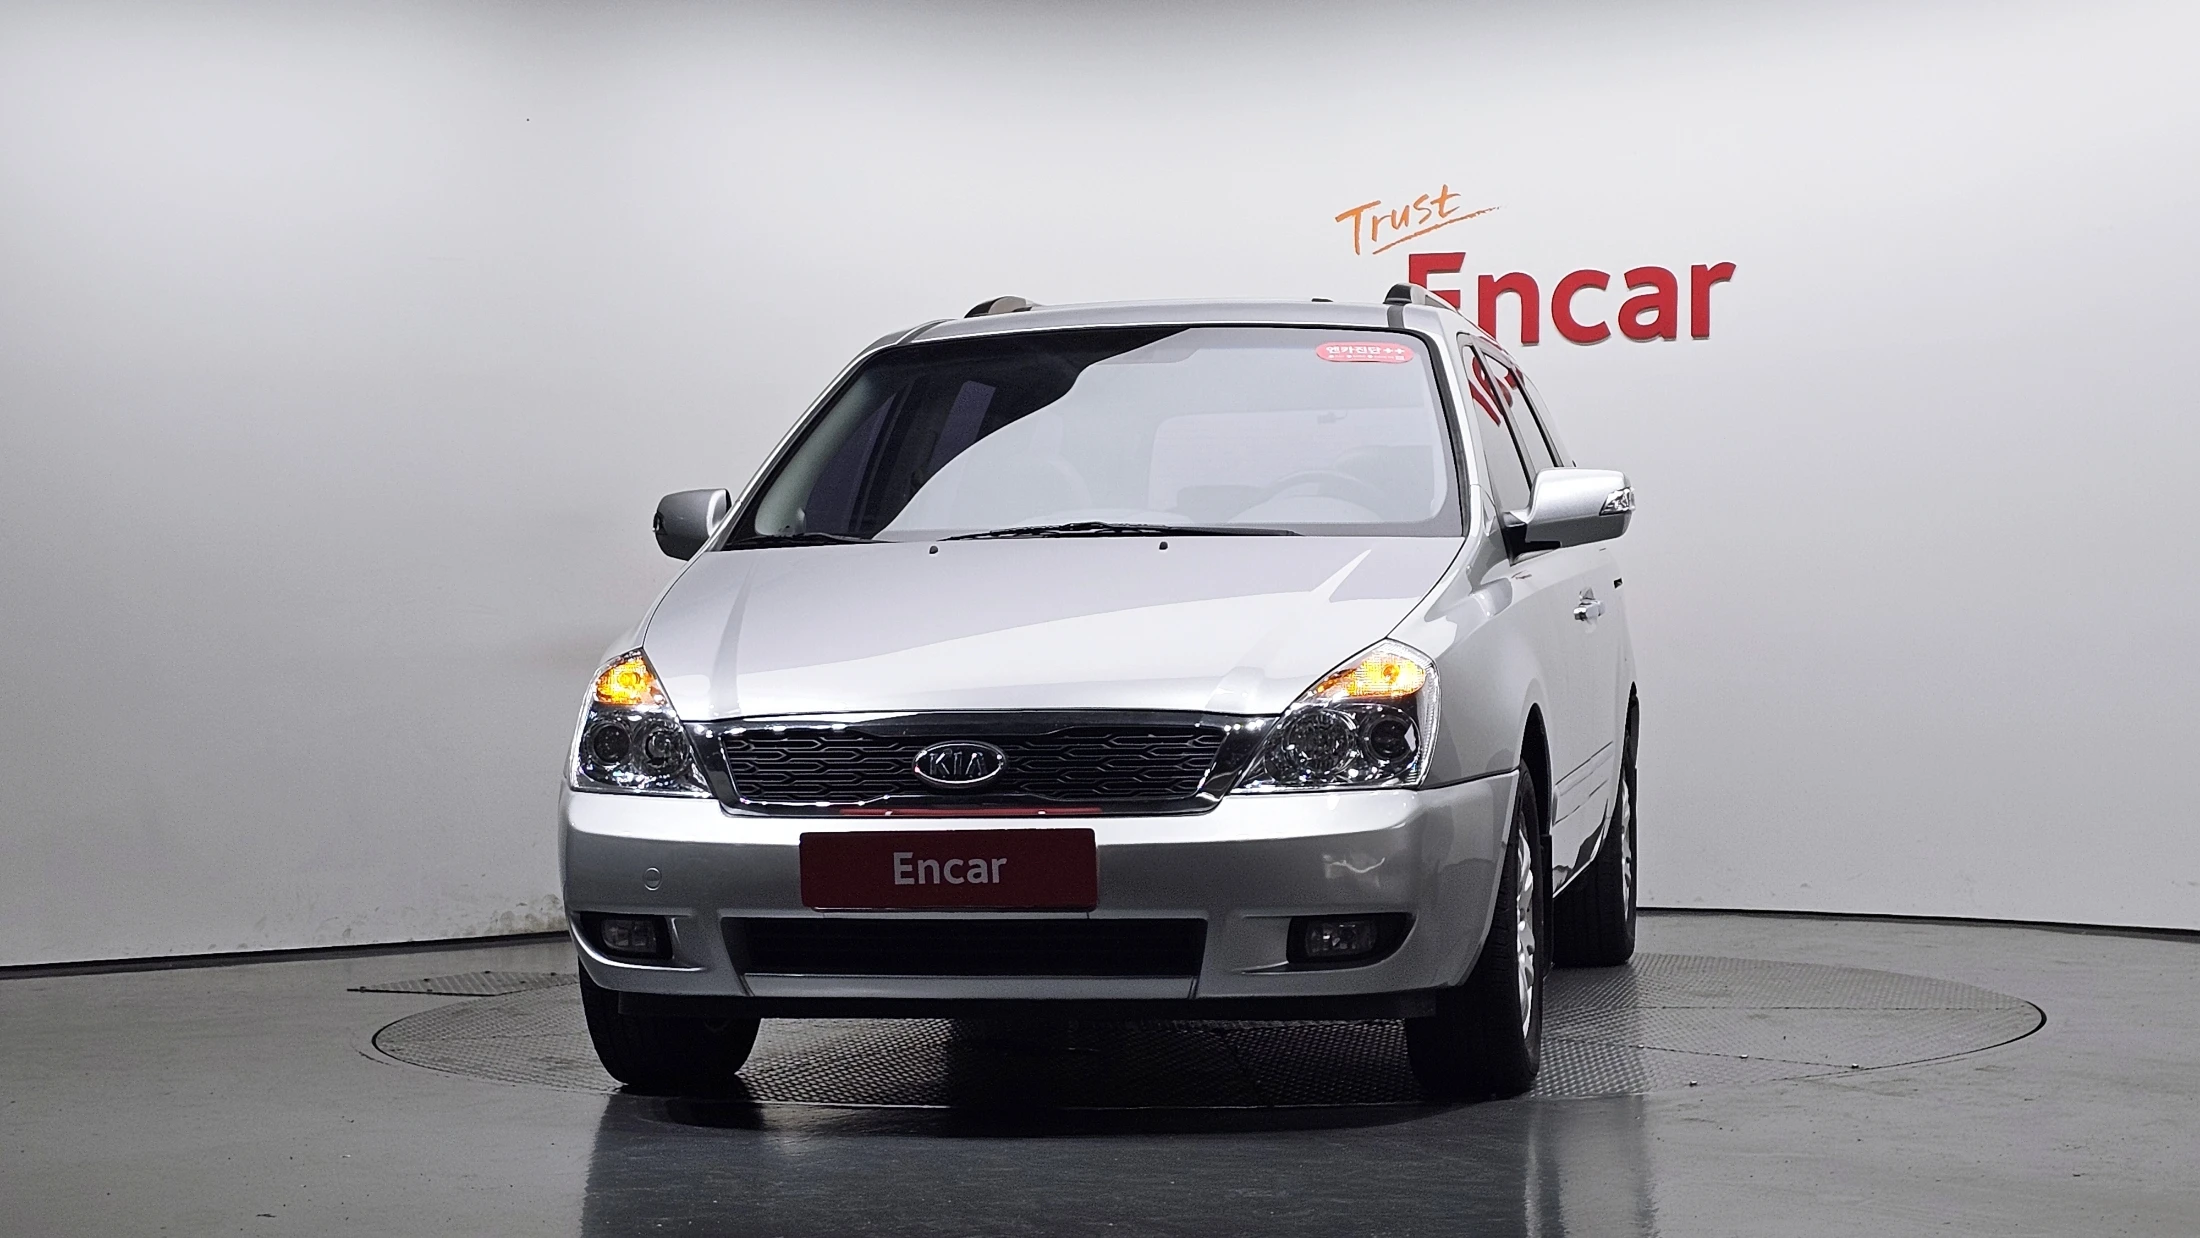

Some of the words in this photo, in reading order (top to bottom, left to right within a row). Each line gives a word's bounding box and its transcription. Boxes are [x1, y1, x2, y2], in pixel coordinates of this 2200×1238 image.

[1335, 184, 1461, 255] Trust
[1408, 251, 1736, 346] Encar
[929, 750, 988, 777] KIA
[893, 852, 1008, 885] Encar
